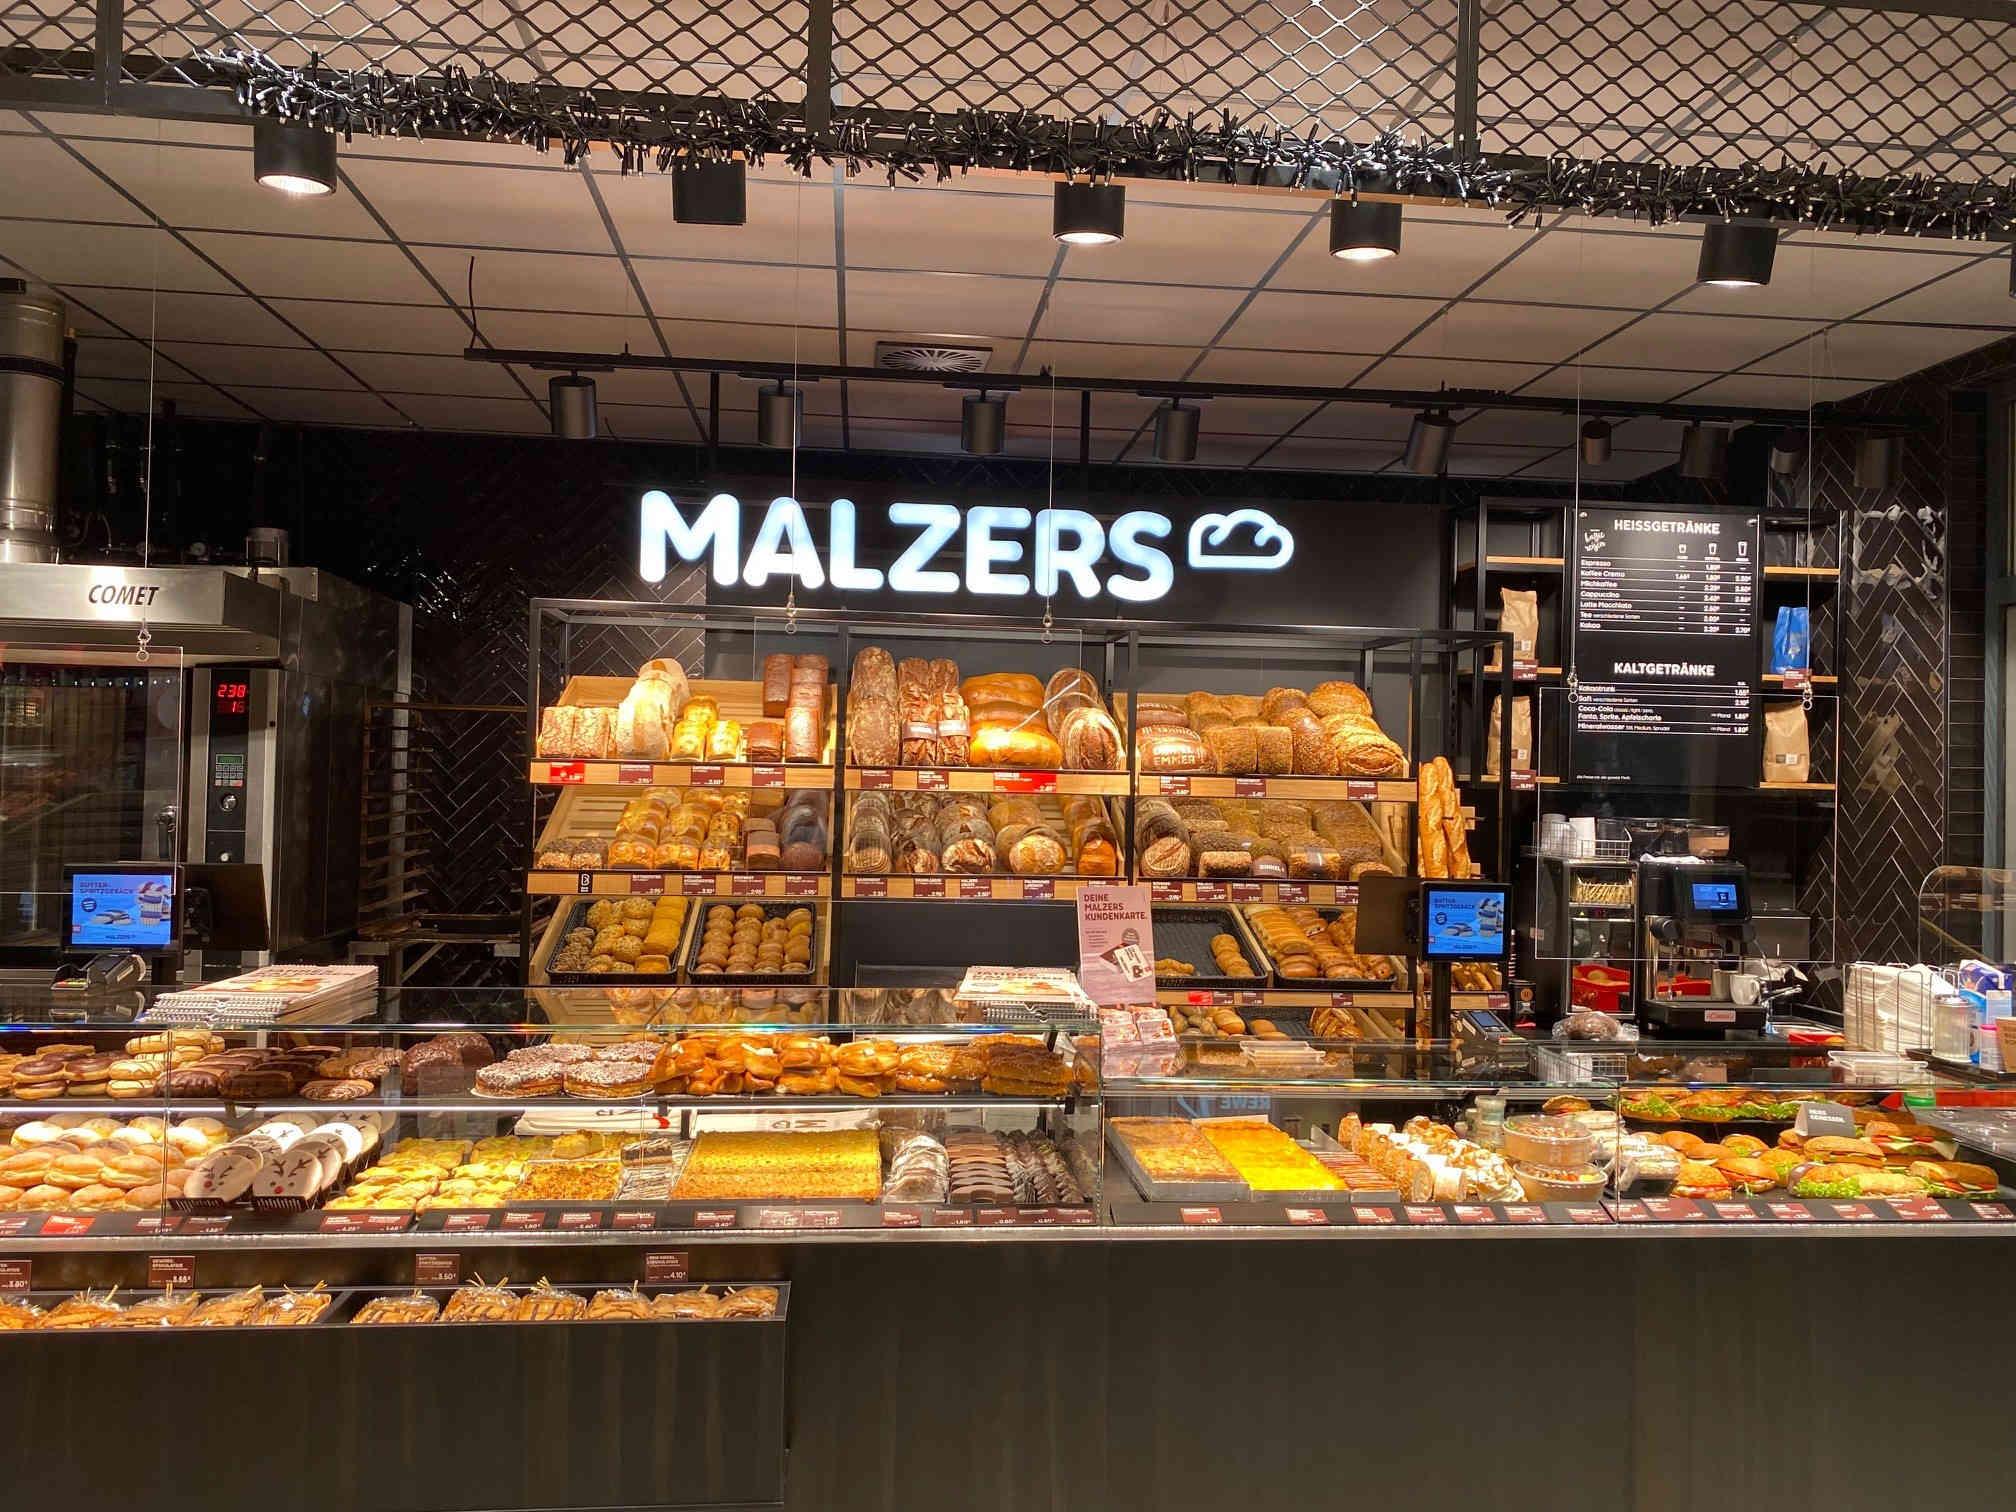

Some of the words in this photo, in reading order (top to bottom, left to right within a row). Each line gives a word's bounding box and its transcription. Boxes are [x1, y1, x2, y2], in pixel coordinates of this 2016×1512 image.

[1614, 519, 1721, 534] HEISSGETRÄNKE
[639, 489, 1175, 602] MALZERS
[88, 584, 159, 606] COMET
[1580, 590, 1620, 598] Cappuccino
[1598, 602, 1632, 610] Macchiato
[1614, 662, 1716, 676] KALTGETRÄNKE
[1578, 722, 1625, 730] Mineralwasser
[1084, 903, 1124, 911] MALZERS
